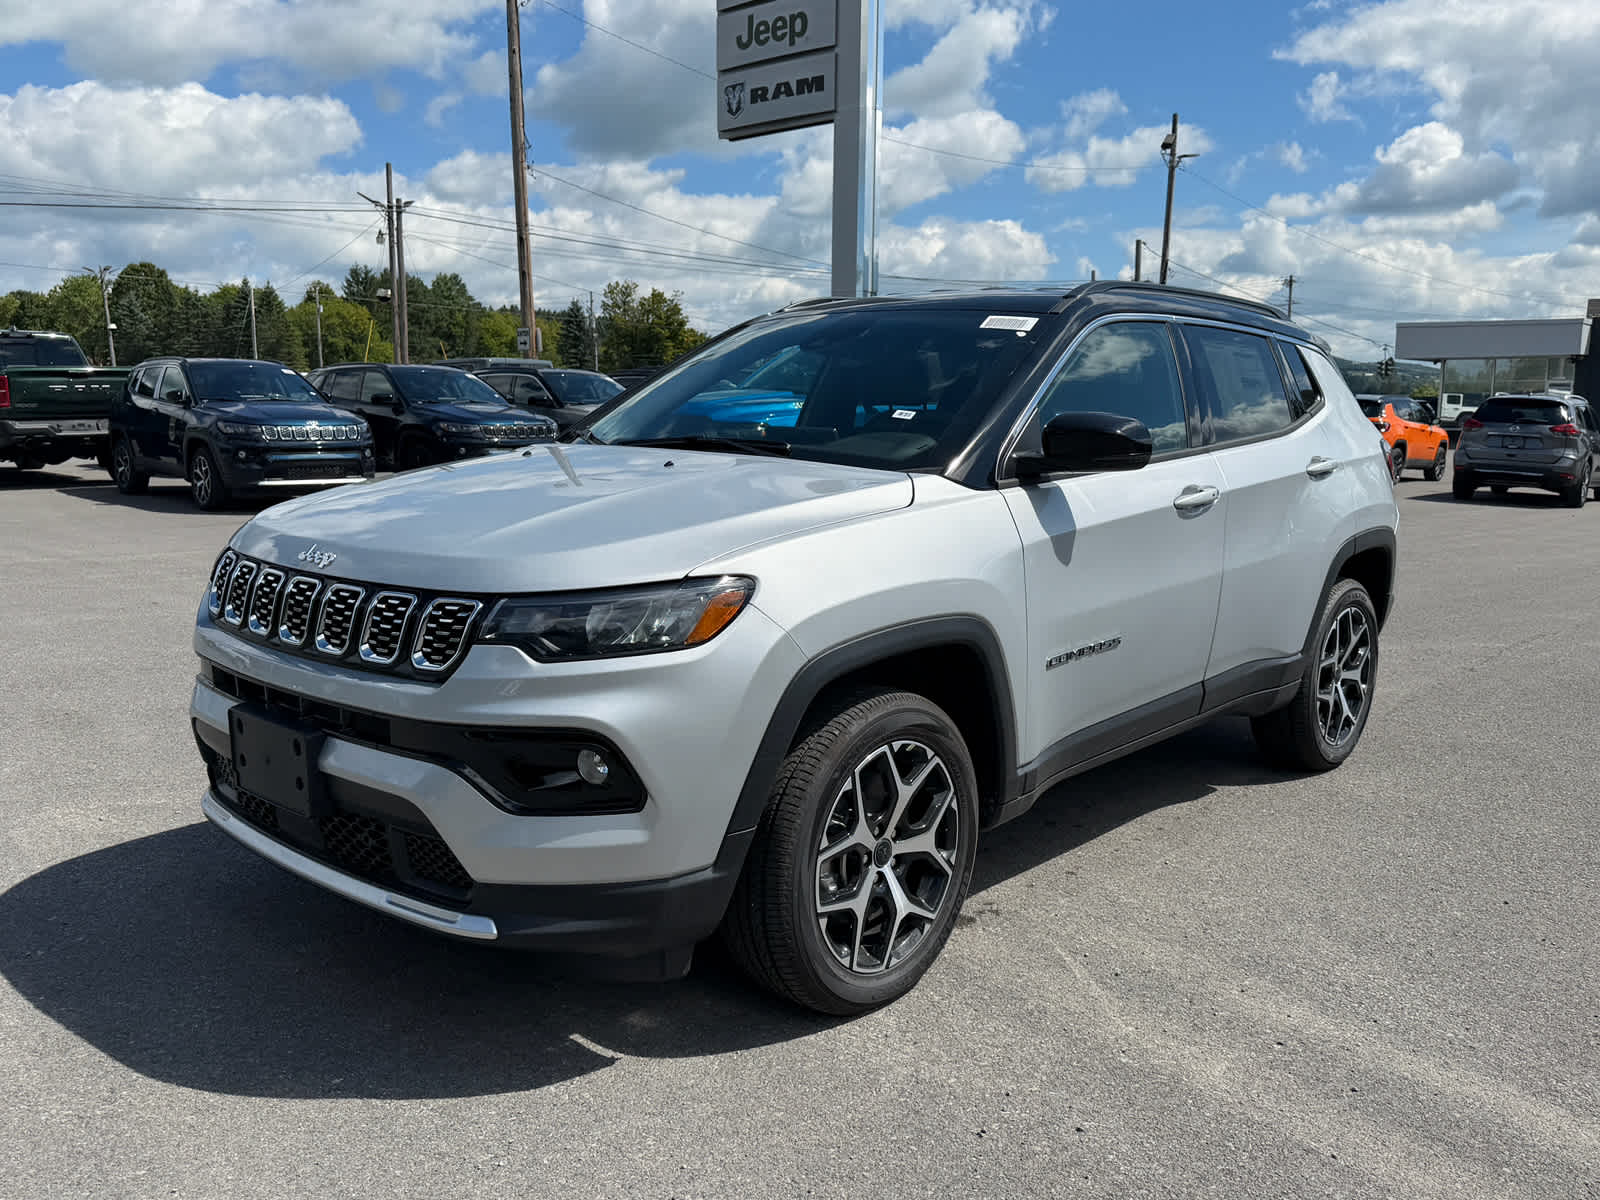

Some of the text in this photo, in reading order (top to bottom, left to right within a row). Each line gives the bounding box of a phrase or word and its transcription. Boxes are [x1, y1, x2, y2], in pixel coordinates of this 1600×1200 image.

[736, 11, 808, 50] Jeep
[750, 75, 824, 104] RAM
[298, 543, 337, 568] Jeep
